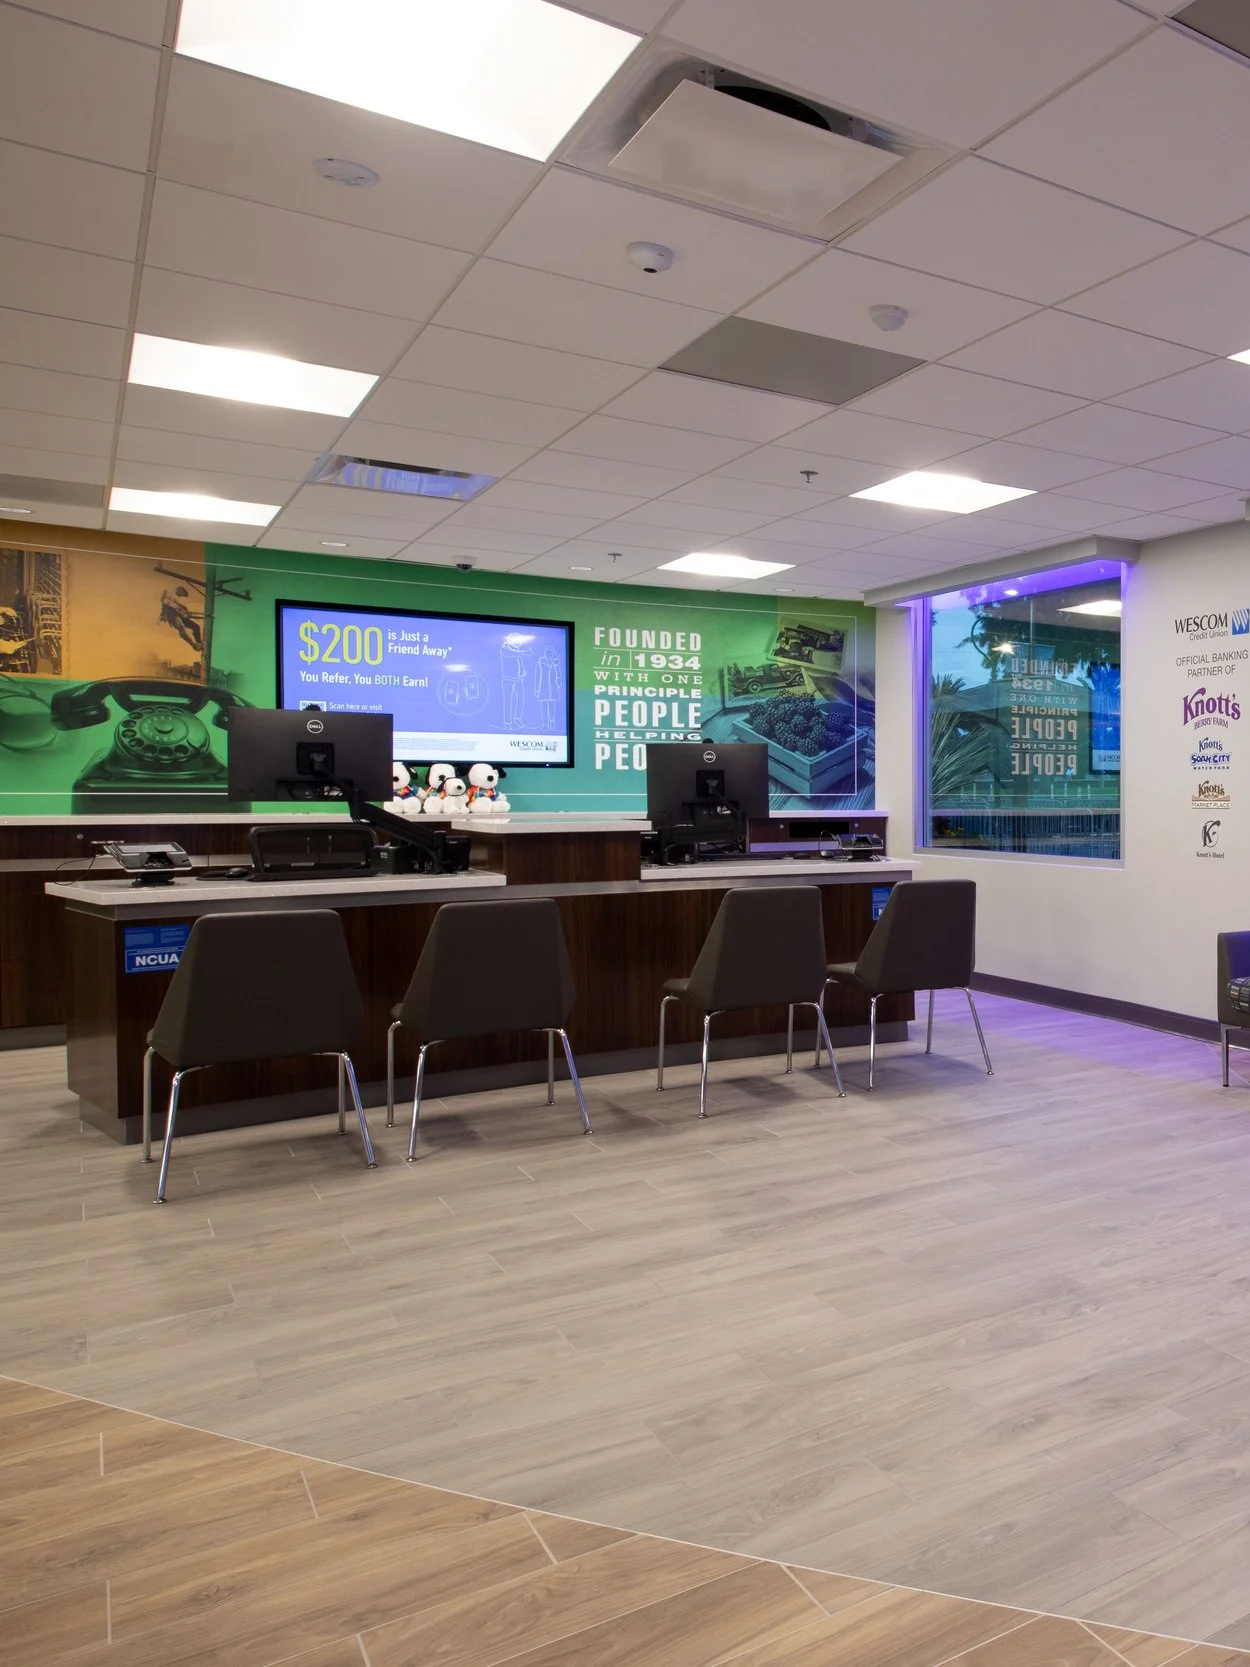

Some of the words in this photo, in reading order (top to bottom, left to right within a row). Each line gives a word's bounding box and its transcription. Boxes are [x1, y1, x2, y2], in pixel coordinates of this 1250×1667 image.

[1174, 611, 1228, 634] WESCOM
[299, 619, 383, 665] $200
[388, 629, 397, 641] is
[400, 630, 421, 642] Just
[423, 634, 429, 643] a
[593, 626, 702, 651] FOUNDED
[1189, 632, 1208, 641] Credit
[1209, 630, 1229, 638] Union
[388, 642, 420, 655] Friend
[601, 650, 621, 667] in
[634, 652, 701, 671] 1934
[1176, 654, 1210, 667] OFFICIAL
[1212, 649, 1249, 663] BANKING
[593, 670, 649, 683] WITH
[661, 674, 703, 685] ONE
[1187, 665, 1223, 678] PARTNER
[1225, 664, 1236, 675] OF
[300, 670, 318, 683] You
[354, 673, 372, 686] You
[374, 674, 400, 687] BOTH
[403, 675, 429, 688] Earn!
[593, 684, 703, 699] PRINCIPLE
[329, 701, 345, 710] Scan
[346, 702, 360, 711] here
[369, 703, 383, 711] visit
[1182, 686, 1241, 726] Knott's
[594, 699, 702, 729] PEOPLE
[1194, 716, 1212, 731] BERRY
[1212, 716, 1229, 729] FARM
[595, 730, 702, 741] HELPING
[509, 740, 544, 748] WESCOM
[1198, 737, 1223, 752] Knott's
[1212, 753, 1231, 764] CITY
[1198, 780, 1225, 797] Knott's
[135, 953, 180, 966] NCUA
